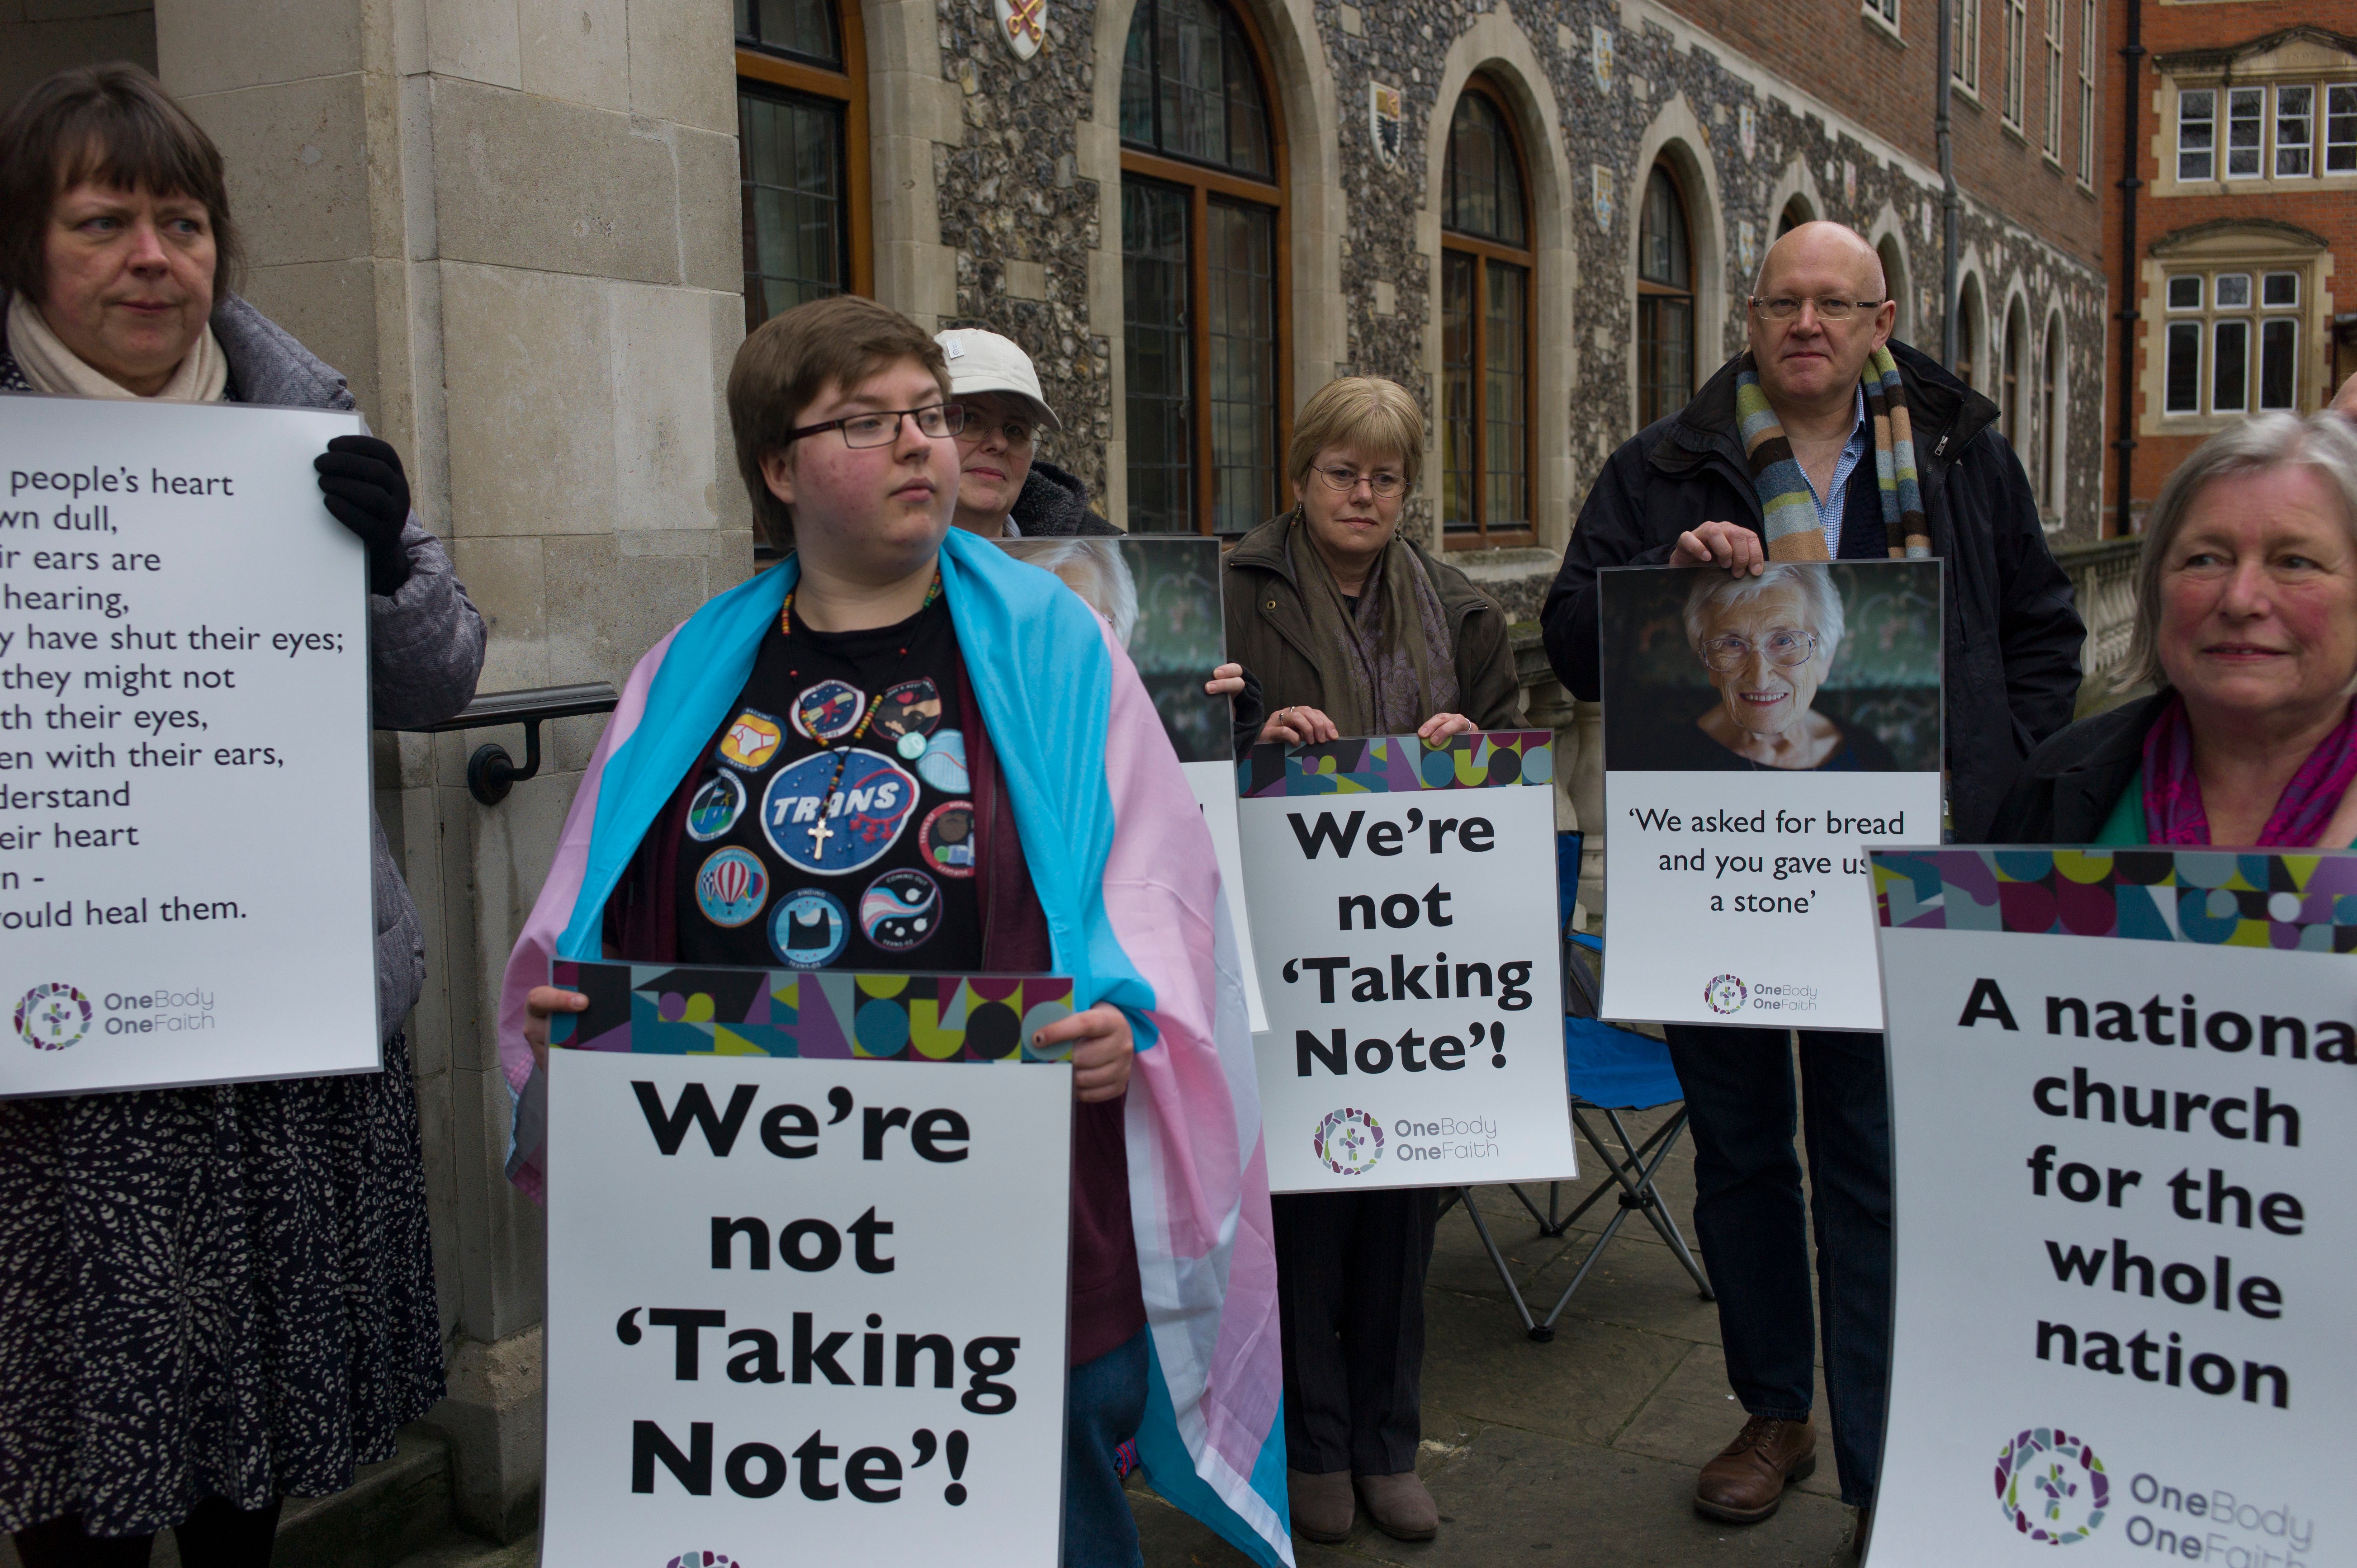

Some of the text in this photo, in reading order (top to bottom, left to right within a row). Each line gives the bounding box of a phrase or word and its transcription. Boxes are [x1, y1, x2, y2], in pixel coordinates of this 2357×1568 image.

[11, 466, 233, 499] people’s heart
[54, 505, 117, 534] dull,
[34, 552, 99, 570] ears
[113, 553, 160, 571] are
[5, 584, 128, 618] hearing,
[28, 623, 97, 649] have
[111, 624, 177, 649] shut
[188, 625, 260, 650] their
[273, 633, 342, 658] eyes;
[2, 663, 235, 697] they might not
[46, 704, 121, 729] their
[135, 711, 207, 736] eyes,
[47, 742, 114, 768] with
[128, 742, 202, 767] their
[215, 748, 283, 767] ears,
[772, 782, 900, 826] TRANS
[1629, 808, 1903, 834] ‘We asked for bread
[55, 823, 139, 848] heart
[1286, 808, 1494, 860] We’re
[1660, 848, 1867, 880] and you gave us
[0, 896, 246, 929] ould heal them.
[1339, 883, 1453, 930] not
[1711, 890, 1815, 913] a stone’
[1283, 952, 1532, 1011] ‘Taking
[1754, 983, 1817, 1001] OneBody
[104, 987, 214, 1011] OneBody
[1753, 998, 1817, 1011] OneFaith
[105, 1013, 215, 1035] OneFaith
[1958, 978, 2357, 1065] A nationa
[1296, 1021, 1506, 1077] Note’!
[631, 1081, 970, 1163] We’re
[2033, 1067, 2300, 1148] church
[1395, 1115, 1496, 1138] OneBody
[1397, 1139, 1498, 1161] OneFaith
[2027, 1145, 2304, 1236] for the
[711, 1206, 894, 1274] not
[2045, 1238, 2282, 1319] whole
[616, 1307, 1020, 1415] ‘Taking
[2036, 1320, 2288, 1409] nation
[632, 1420, 969, 1506] Note’!
[2130, 1473, 2314, 1553] OneBody
